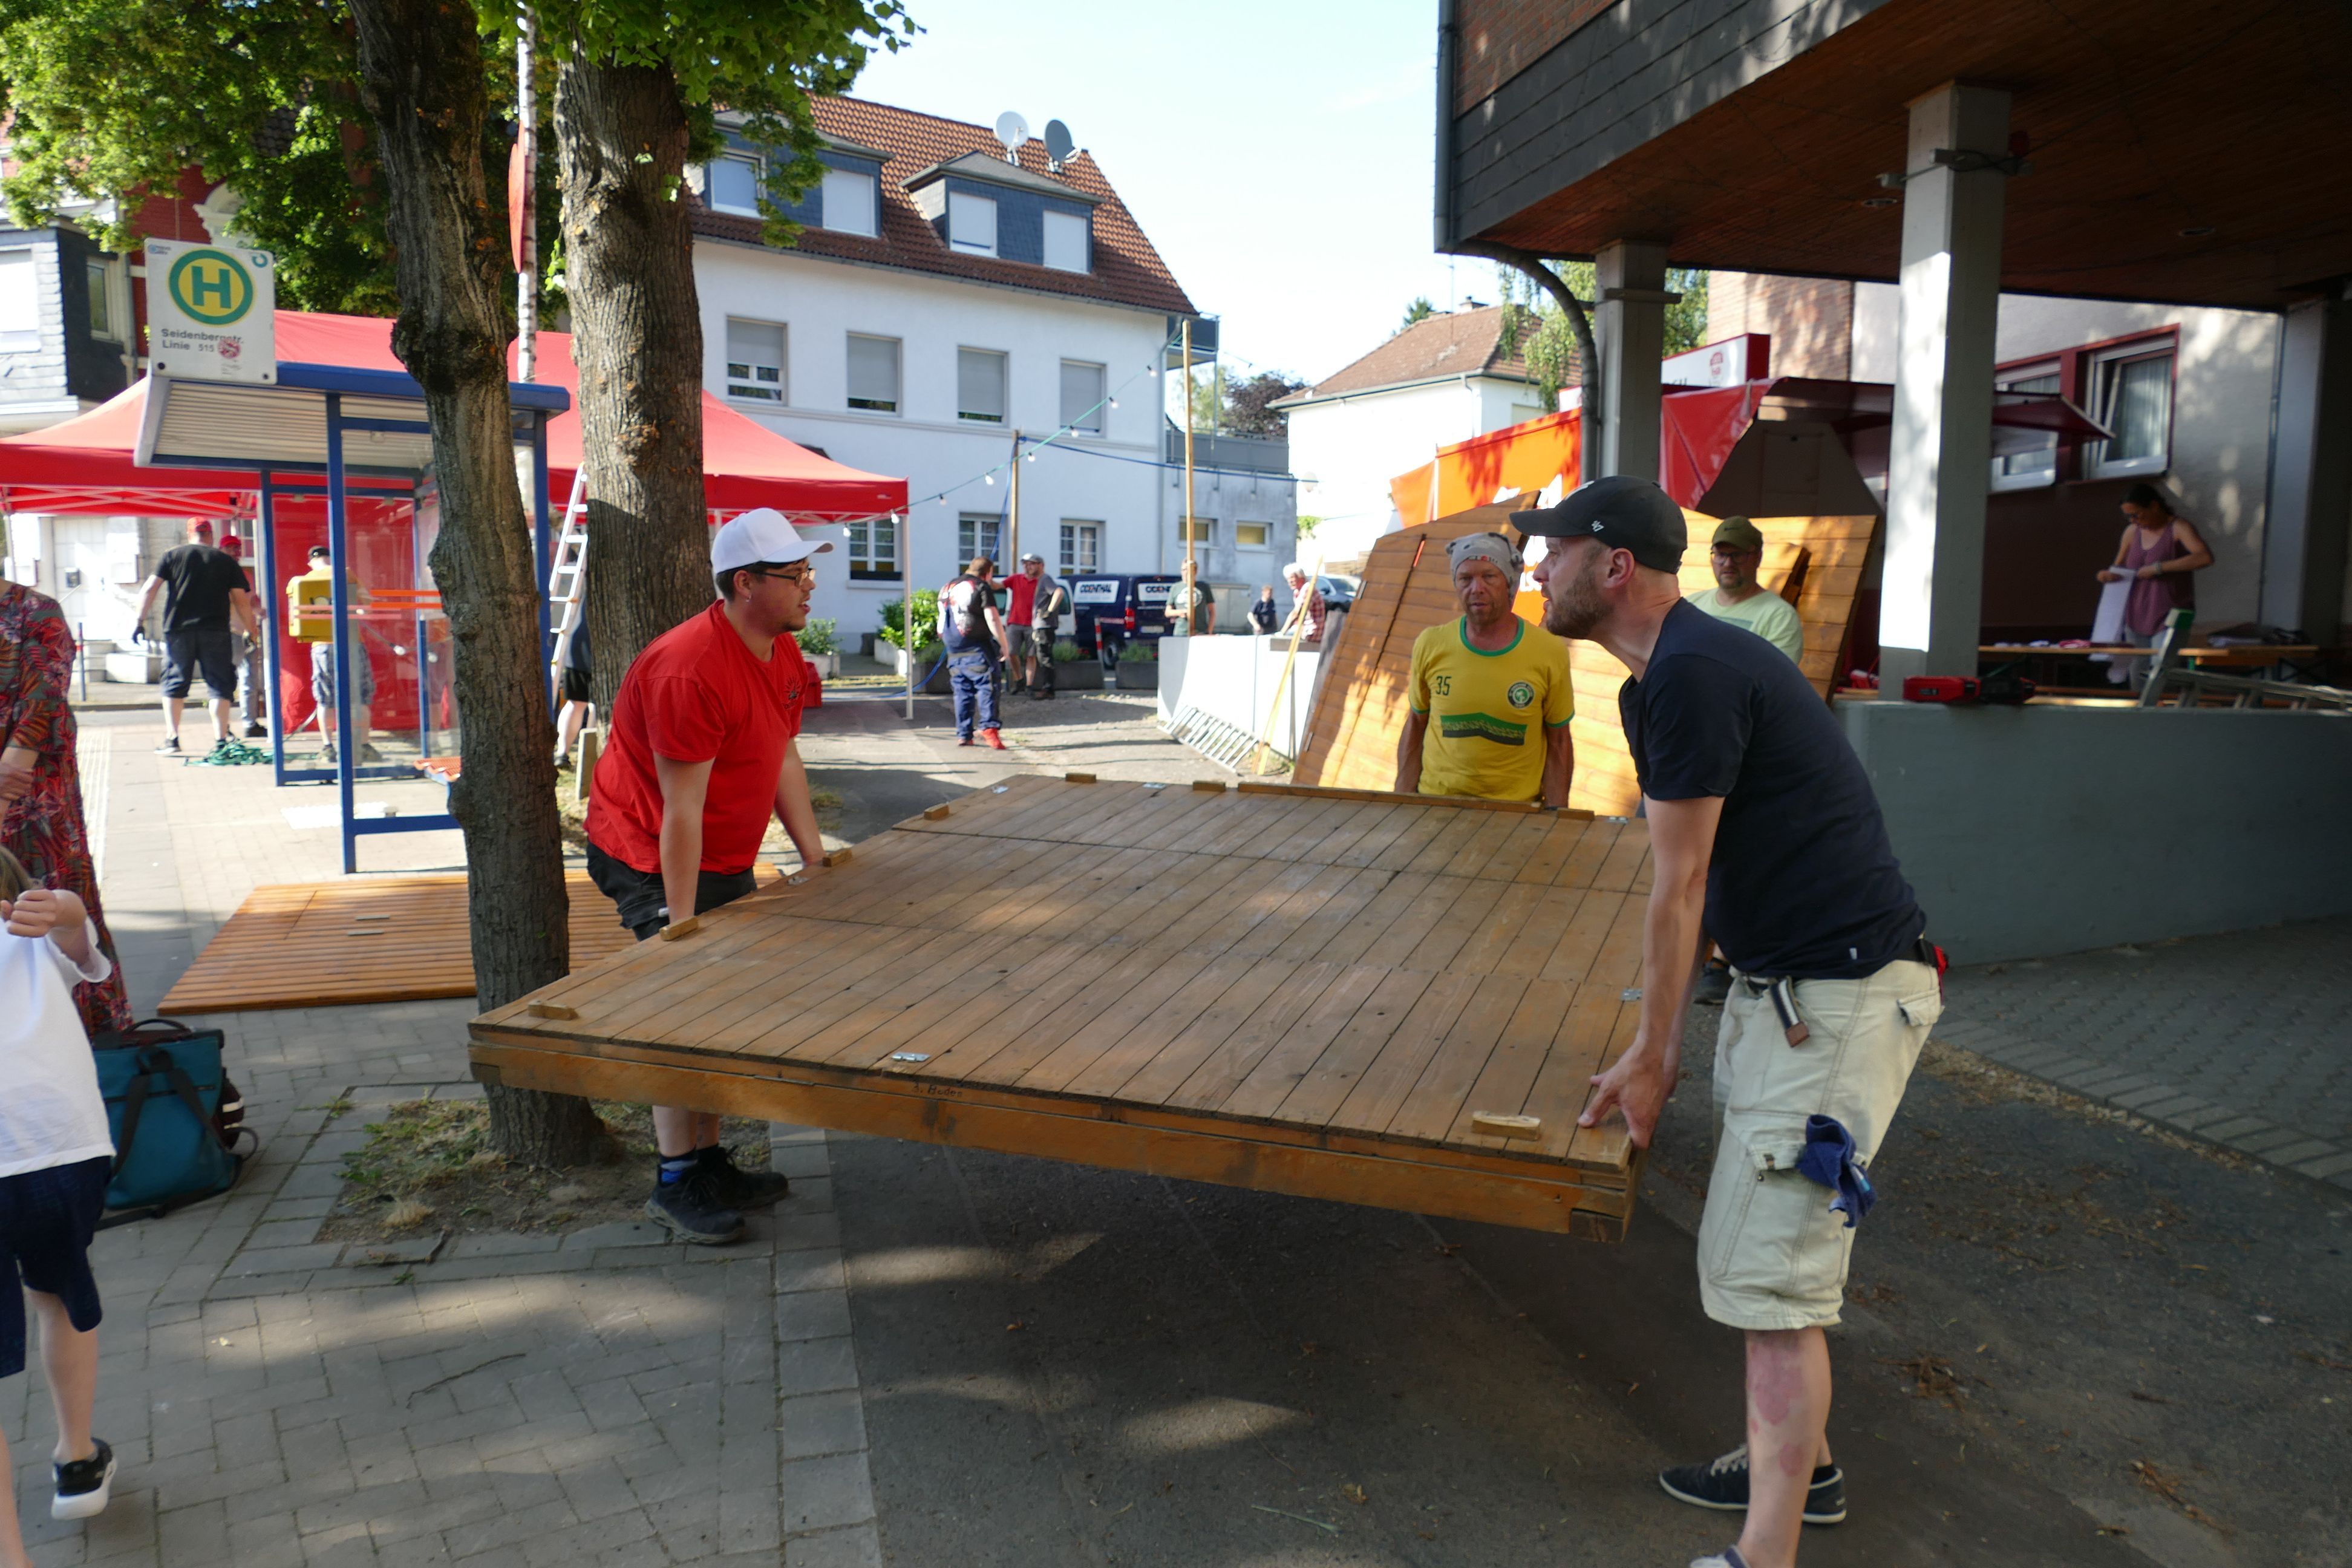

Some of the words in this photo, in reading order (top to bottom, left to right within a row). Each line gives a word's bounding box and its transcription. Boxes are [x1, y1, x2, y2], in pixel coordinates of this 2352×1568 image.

[191, 266, 231, 309] H
[163, 340, 191, 350] Linie
[1436, 676, 1452, 696] 35
